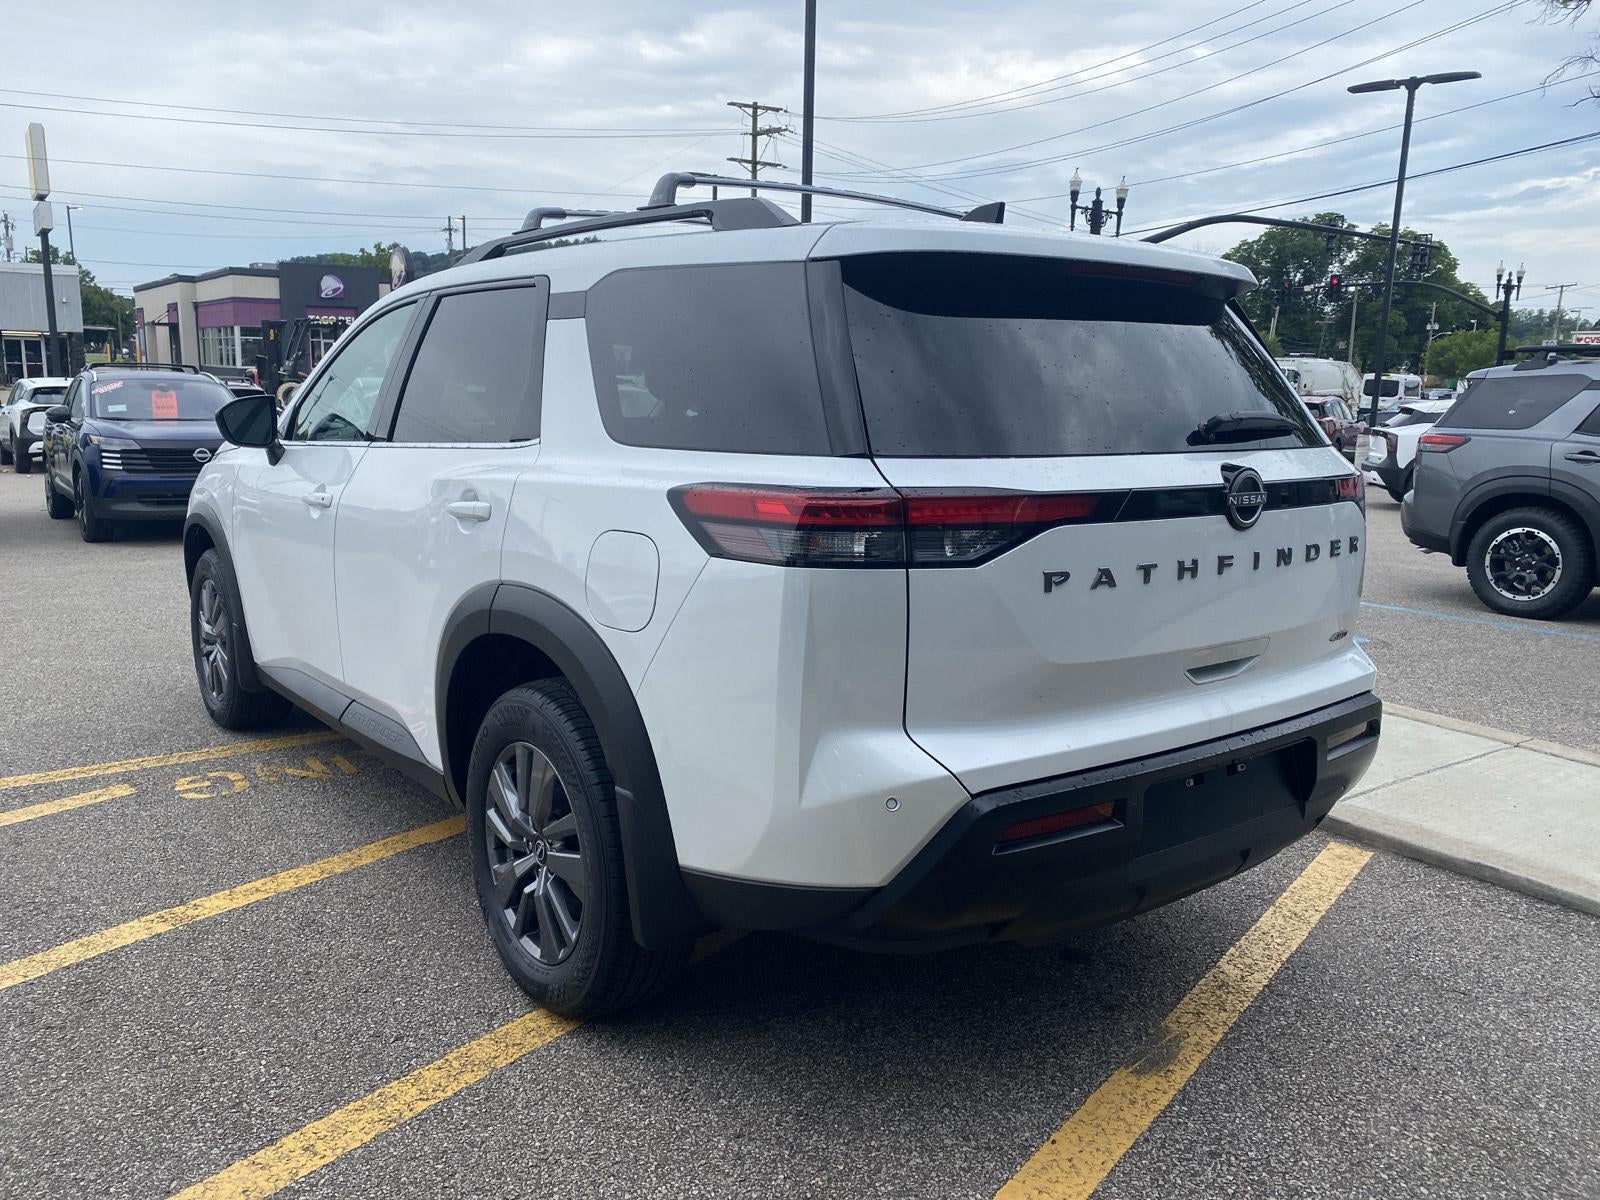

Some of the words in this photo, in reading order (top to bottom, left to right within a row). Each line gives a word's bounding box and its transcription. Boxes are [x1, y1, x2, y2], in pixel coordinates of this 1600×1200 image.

[308, 315, 337, 325] TACO
[1583, 336, 1600, 344] CVS
[1229, 494, 1267, 505] NISSAN
[1043, 536, 1360, 593] PATHFINDER
